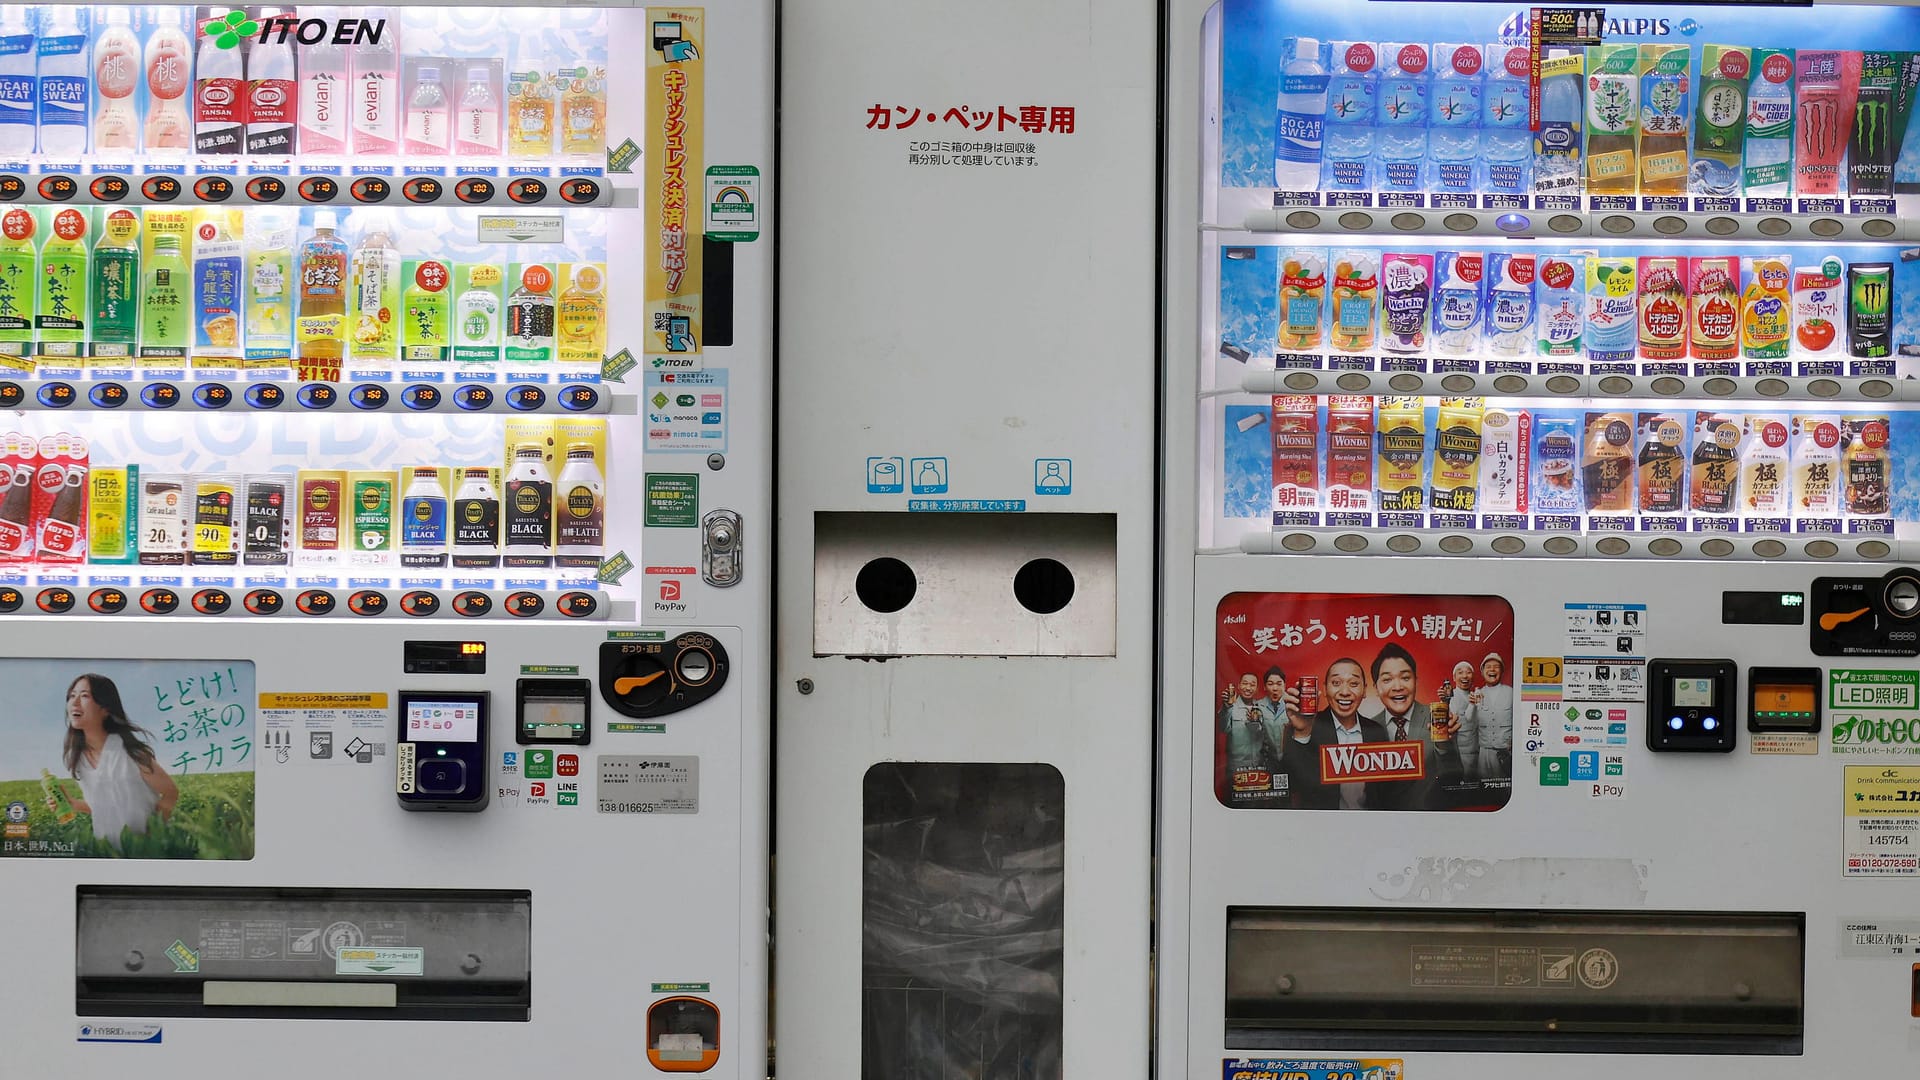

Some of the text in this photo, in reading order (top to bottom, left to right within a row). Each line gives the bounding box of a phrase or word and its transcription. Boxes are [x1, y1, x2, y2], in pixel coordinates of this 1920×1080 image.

[259, 18, 386, 45] ITO EN
[104, 57, 126, 82] 桃
[156, 57, 178, 81] 桃
[1767, 67, 1787, 78] 爽快
[1806, 60, 1834, 74] 上陸
[43, 82, 85, 93] POCARI
[43, 90, 83, 101] SWEAT
[317, 80, 329, 122] evian
[366, 81, 378, 122] evian
[201, 108, 233, 117] TANSAN
[253, 109, 284, 117] TANSAN
[1605, 88, 1622, 131] 十六茶
[1757, 103, 1790, 112] MITSUYA
[866, 104, 1075, 134] カン・ペット専用
[1766, 111, 1790, 120] CIDER
[1281, 117, 1324, 130] POCARI
[1650, 116, 1682, 131] 麦茶
[1281, 126, 1320, 138] SWEAT
[909, 142, 1036, 154] このゴミ箱の中身は回収後
[908, 154, 1039, 167] 再分別して処理しています。
[1334, 162, 1364, 170] NATURAL
[1440, 172, 1470, 180] MINERAL
[1491, 172, 1520, 180] MINERAL
[1391, 178, 1413, 186] WATER
[1494, 180, 1517, 188] WATER
[1462, 260, 1480, 269] New
[1514, 262, 1533, 270] New
[221, 270, 233, 294] 黄金
[304, 267, 341, 286] むぎ茶
[1389, 267, 1424, 288] 濃い
[365, 270, 378, 307] そば茶
[1766, 280, 1784, 288] 食感
[148, 296, 181, 305] お抹茶
[1389, 298, 1424, 310] Welch's
[1444, 298, 1473, 312] 濃いめ
[1496, 300, 1525, 314] 濃いめ
[1816, 303, 1838, 316] トマト
[1294, 314, 1314, 322] TEA
[1649, 314, 1680, 323] ドデカミン
[1702, 314, 1733, 324] ドデカミン
[1651, 325, 1678, 335] ストロング
[1704, 326, 1732, 335] ストロング
[1280, 434, 1312, 446] WONDA
[1334, 436, 1368, 446] WONDA
[1388, 436, 1421, 448] WONDA
[1443, 434, 1478, 450] WONDA
[1768, 434, 1784, 442] 豊か
[1819, 434, 1836, 443] 豊か
[1390, 453, 1418, 461] 金の微糖
[1444, 452, 1474, 462] 金の微糖
[1497, 440, 1508, 499] 白いカフェラテ
[1600, 462, 1620, 480] 極
[1651, 461, 1672, 480] 極
[1752, 482, 1780, 490] カフェオレ
[1805, 482, 1832, 490] カフェオレ
[1279, 488, 1297, 506] 朝
[1298, 497, 1316, 506] 専用
[1330, 490, 1348, 508] 朝
[1402, 491, 1422, 511] 休憩
[1453, 490, 1475, 510] 休憩
[1350, 499, 1367, 508] 専用
[250, 507, 278, 516] BLACK
[356, 516, 389, 524] ESPRESSO
[150, 529, 166, 543] 20
[202, 528, 220, 542] 90
[654, 602, 686, 612] PayPay
[1224, 614, 1246, 624] Asahi
[1526, 662, 1560, 678] iD
[1850, 674, 1916, 682] 省エネで環境にやさしい
[1840, 687, 1908, 704] LED照明
[1536, 702, 1560, 710] nanaco
[164, 703, 246, 743] お茶の
[1528, 728, 1542, 737] Edy
[171, 735, 252, 775] チカラ
[1326, 746, 1416, 774] WONDA
[1605, 756, 1622, 764] LINE
[1606, 766, 1621, 774] Pay
[506, 788, 520, 798] Pay
[1603, 784, 1624, 798] Pay
[559, 794, 576, 804] Pay
[600, 802, 654, 812] 138 016625
[1869, 836, 1908, 845] 145754
[94, 1028, 124, 1036] HYBRID
